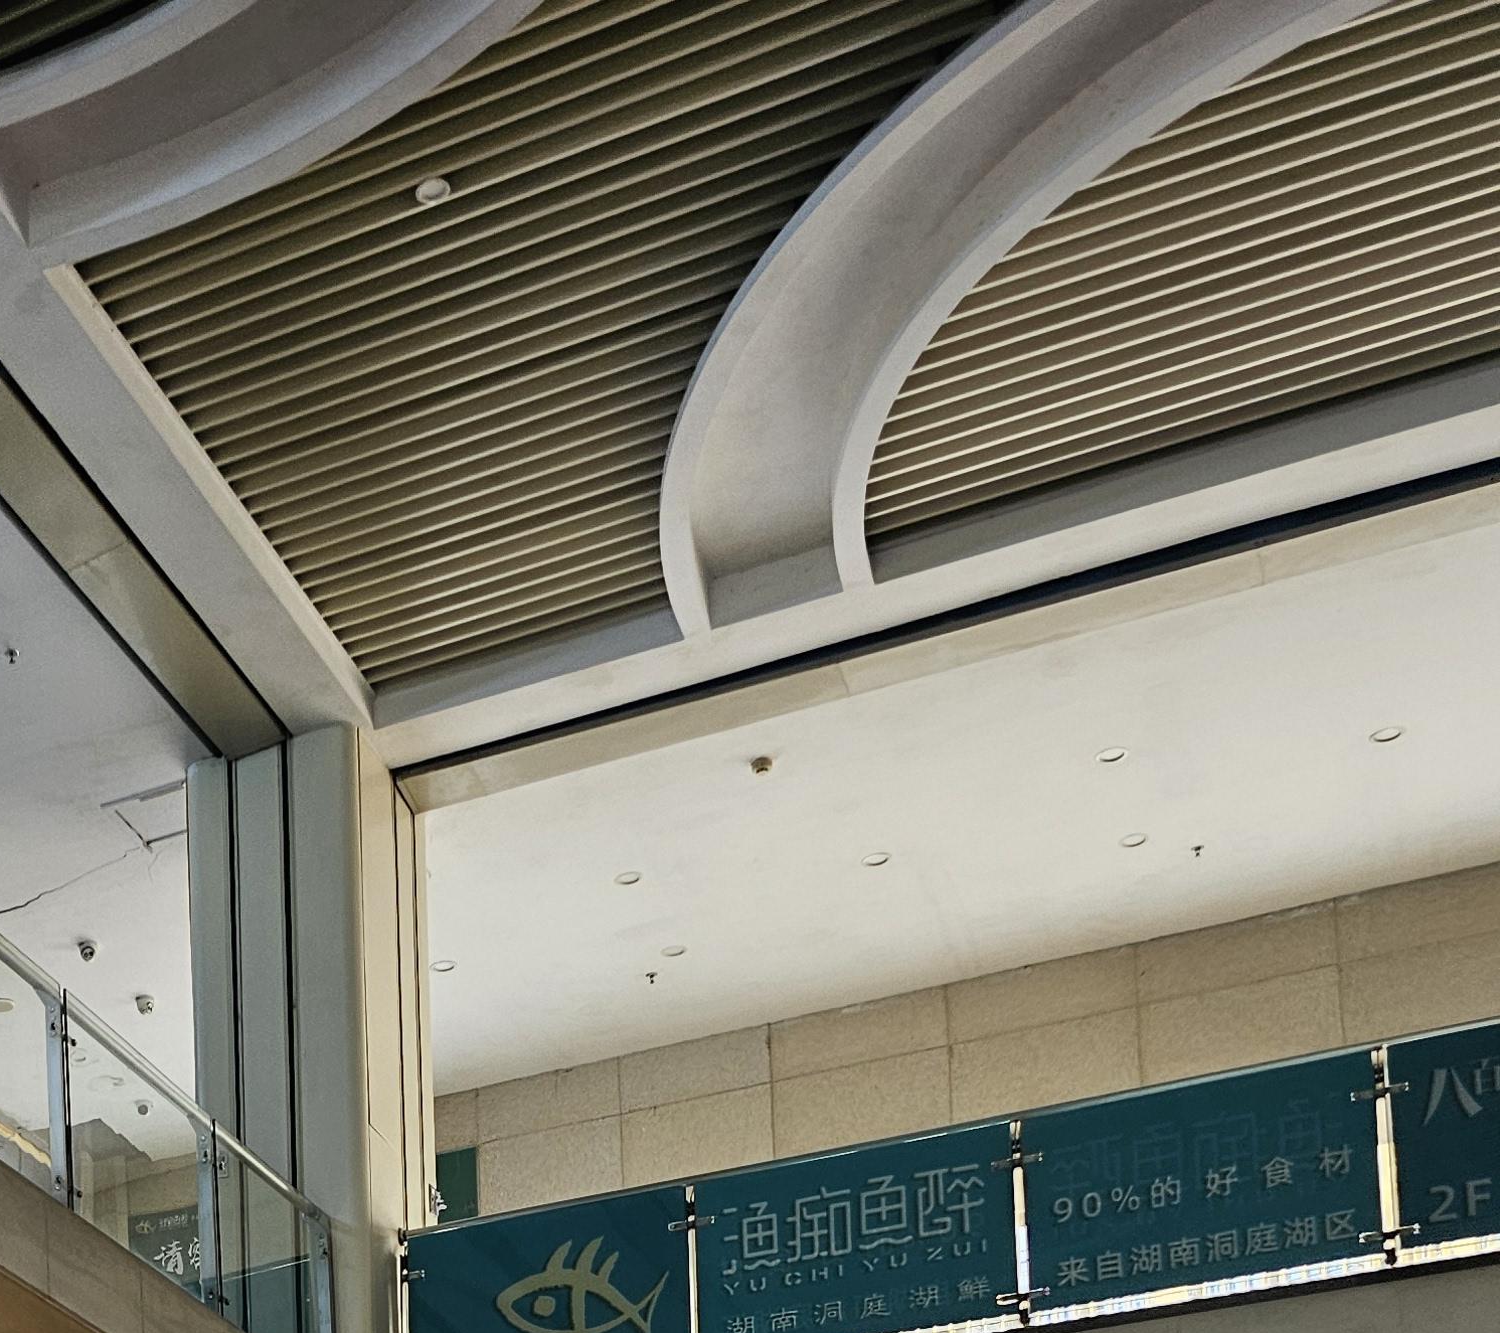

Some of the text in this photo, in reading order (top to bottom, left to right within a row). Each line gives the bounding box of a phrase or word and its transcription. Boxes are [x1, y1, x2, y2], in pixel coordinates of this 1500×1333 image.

[1428, 1177, 1493, 1223] 2F
[723, 1276, 766, 1296] YU
[862, 1253, 908, 1272] YU
[927, 1239, 987, 1261] ZUI
[1057, 1208, 1356, 1288] 来自湖南洞庭湖区
